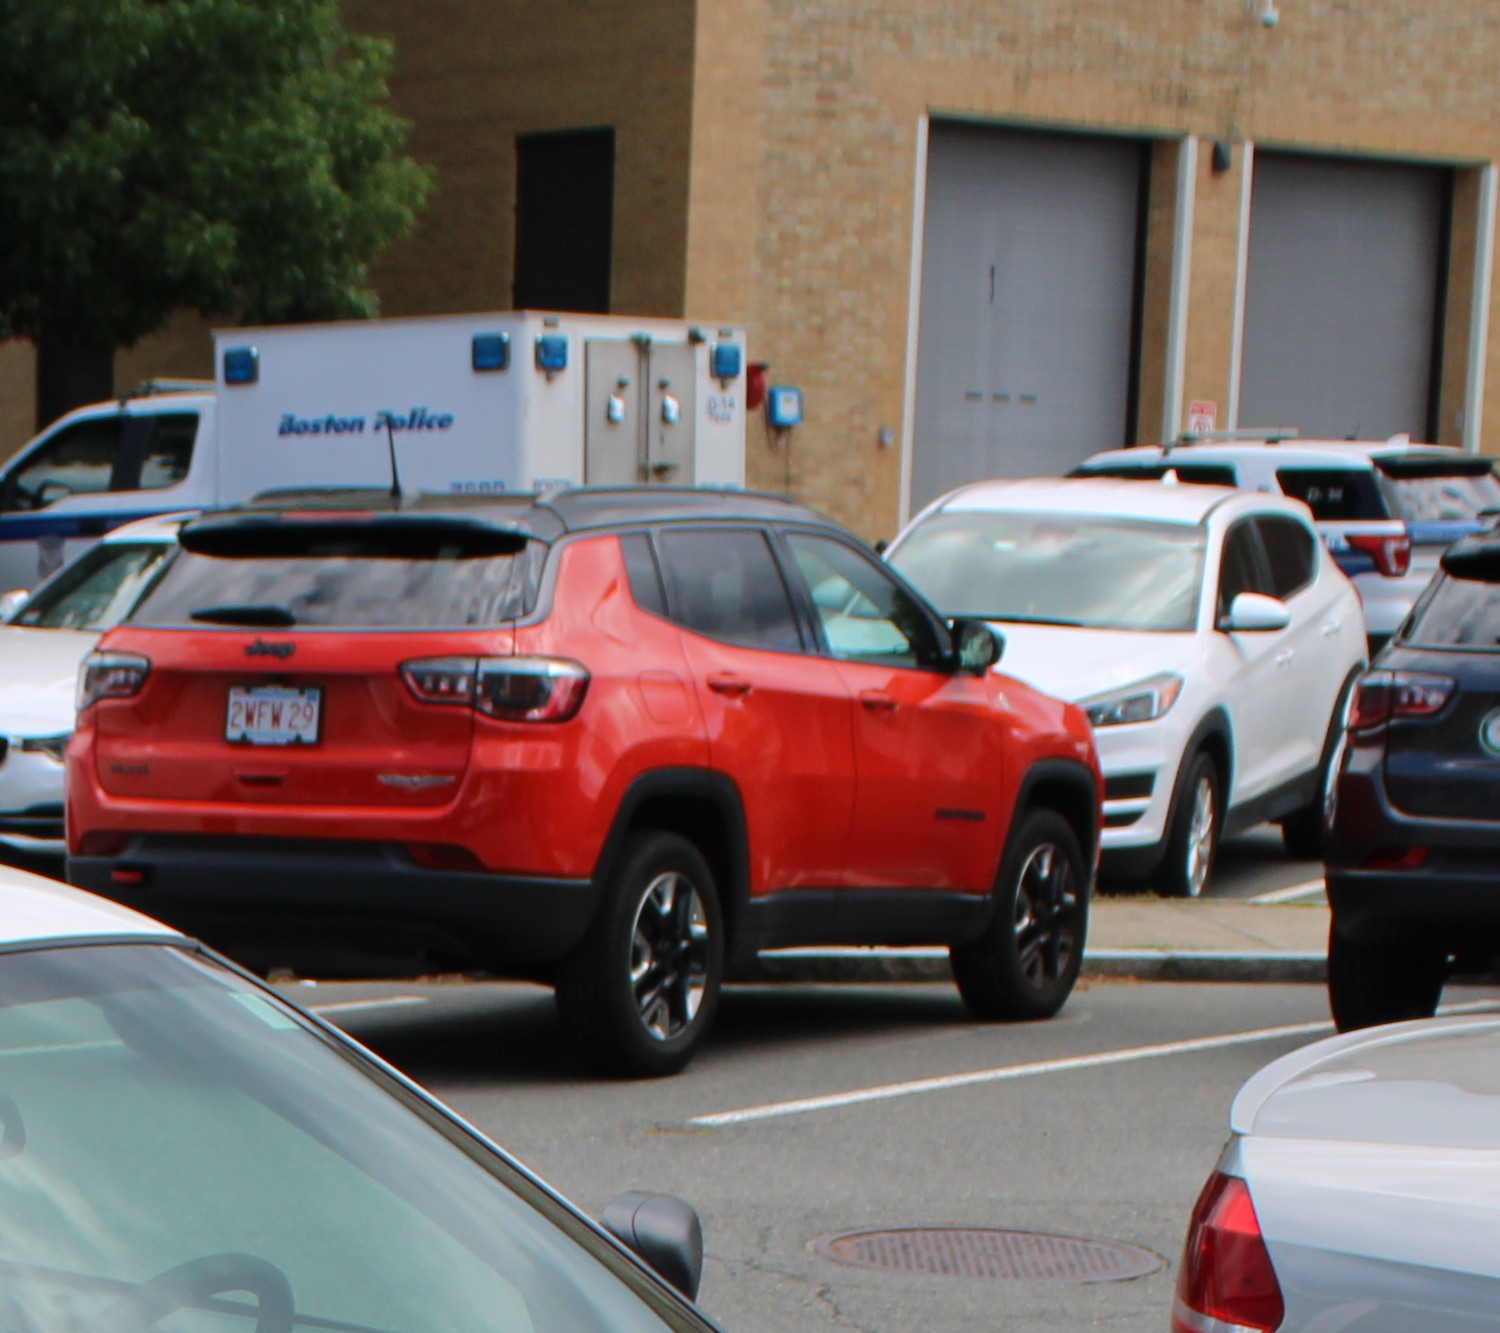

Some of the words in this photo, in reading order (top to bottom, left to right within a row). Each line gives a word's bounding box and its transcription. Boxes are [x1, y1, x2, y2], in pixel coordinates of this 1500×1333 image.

[278, 412, 366, 436] Boston
[374, 407, 455, 431] Police
[244, 637, 296, 660] Jeep
[230, 701, 283, 729] 2WFW
[289, 702, 315, 730] 29
